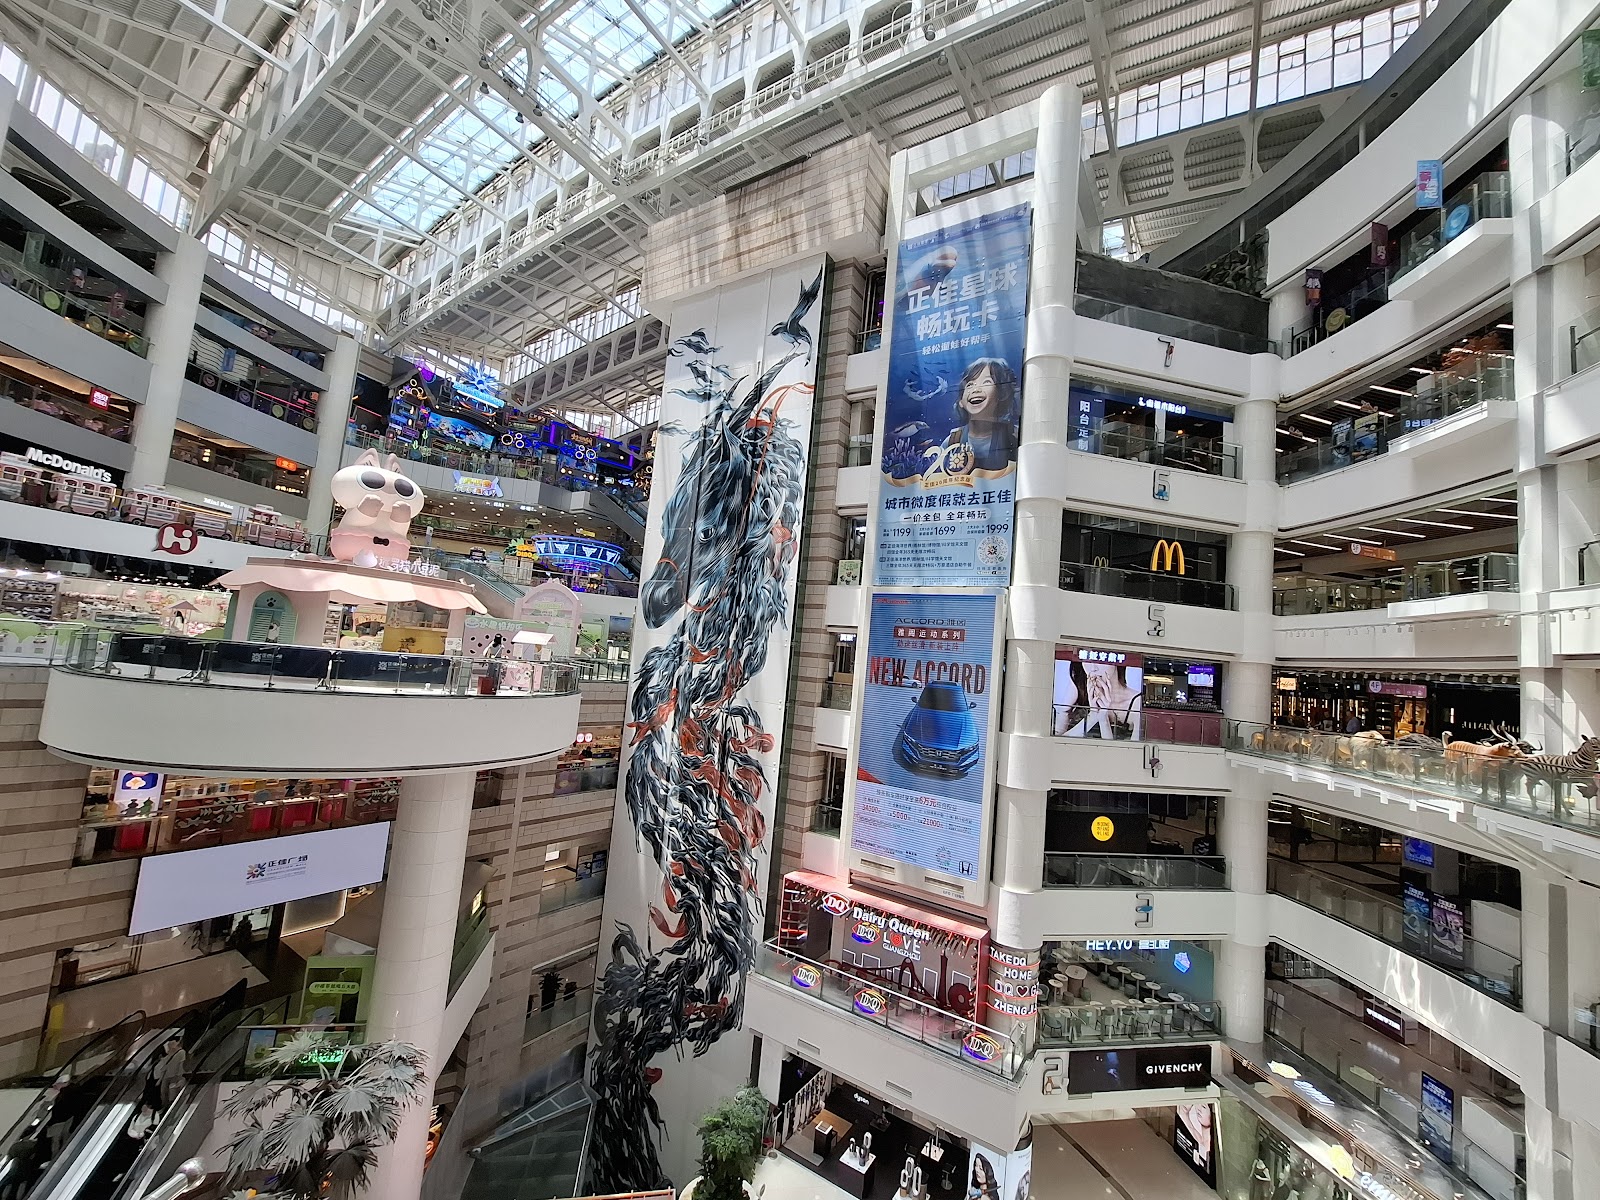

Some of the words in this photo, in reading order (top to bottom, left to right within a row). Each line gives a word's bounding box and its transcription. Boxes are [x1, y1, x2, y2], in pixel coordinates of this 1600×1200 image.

[906, 263, 1018, 315] 正佳星球
[916, 300, 1000, 341] 畅玩卡
[922, 333, 991, 355] 轻松遛娃好帮手
[1157, 336, 1176, 368] 7
[1077, 400, 1091, 451] 阳台定制
[26, 447, 112, 483] McDonald's
[1152, 469, 1171, 501] 6
[885, 489, 1012, 511] 城市微度假就去正佳
[903, 513, 941, 523] 一价全包
[946, 509, 987, 520] 全年畅玩
[892, 528, 911, 537] 1199
[934, 526, 956, 535] 1699
[985, 523, 1009, 534] 1999
[894, 618, 945, 626] ACCORD
[1147, 604, 1166, 637] 5
[898, 628, 961, 640] 雅阁运动系列
[869, 656, 907, 686] NEW
[913, 659, 986, 694] ACCORD
[1370, 681, 1380, 689] 4F
[1143, 744, 1163, 778] 4
[826, 897, 846, 913] DQ
[1134, 892, 1154, 928] 3
[853, 907, 887, 928] Dairy
[888, 918, 931, 941] Queen
[855, 924, 877, 943] DQ
[883, 943, 921, 960] GUANGZHOU
[798, 968, 817, 985] DQ
[1004, 967, 1033, 980] HOME
[995, 979, 1013, 997] DQ
[861, 994, 881, 1013] DQ
[969, 1036, 995, 1059] DQ
[1146, 1062, 1203, 1074] GIVENCHY
[853, 1093, 870, 1106] dyson
